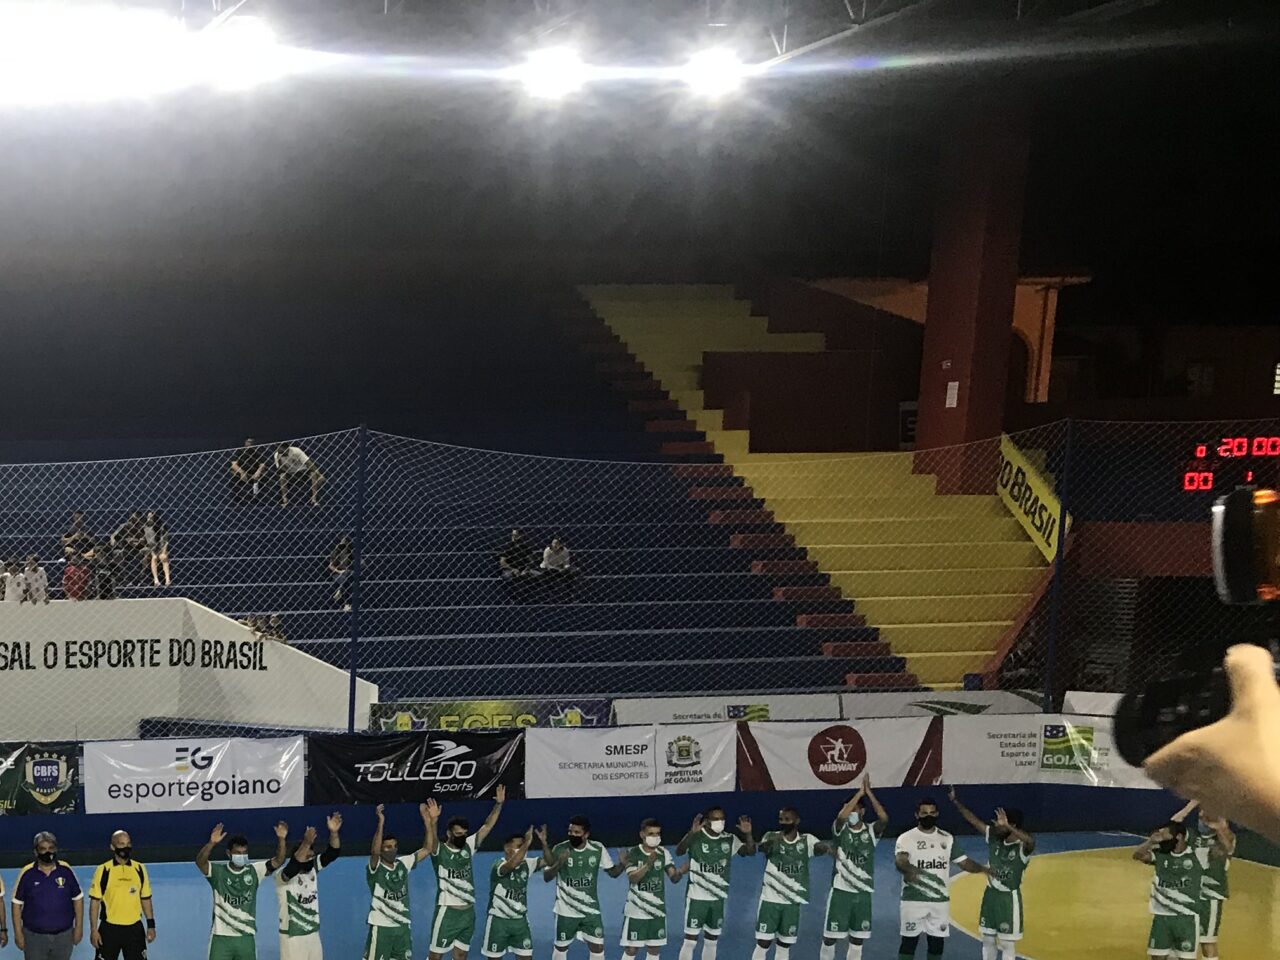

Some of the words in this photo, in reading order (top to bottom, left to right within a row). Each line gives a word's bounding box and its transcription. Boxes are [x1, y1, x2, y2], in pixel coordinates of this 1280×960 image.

[1184, 472, 1214, 490] 00
[1009, 465, 1056, 548] BRASIL
[43, 640, 58, 670] O
[64, 638, 162, 670] ESPORTE
[168, 638, 196, 669] DO
[201, 640, 268, 672] BRASIL
[986, 731, 1027, 739] Secretaria
[1027, 731, 1038, 739] de
[604, 744, 649, 756] SMESP
[999, 741, 1026, 749] Estado
[1027, 741, 1037, 749] de
[1001, 750, 1031, 759] Esporte
[558, 761, 605, 770] SECRETARIA
[606, 760, 648, 769] MUNICIPAL
[819, 762, 858, 773] MIDWAY
[1015, 759, 1036, 767] Lazer
[33, 765, 59, 777] CBFS
[354, 760, 477, 782] TOLLEDO
[592, 773, 609, 781] DOS
[610, 771, 649, 780] ESPORTES
[107, 774, 282, 804] esportegoiano
[432, 781, 474, 793] Sports
[701, 843, 710, 853] 12
[916, 841, 927, 850] 22
[567, 857, 574, 867] 9
[917, 859, 948, 870] Italac
[690, 918, 699, 928] 12
[905, 922, 917, 931] 22
[560, 932, 566, 941] 9
[630, 931, 638, 940] 10
[442, 938, 448, 948] 7
[492, 943, 497, 952] 8
